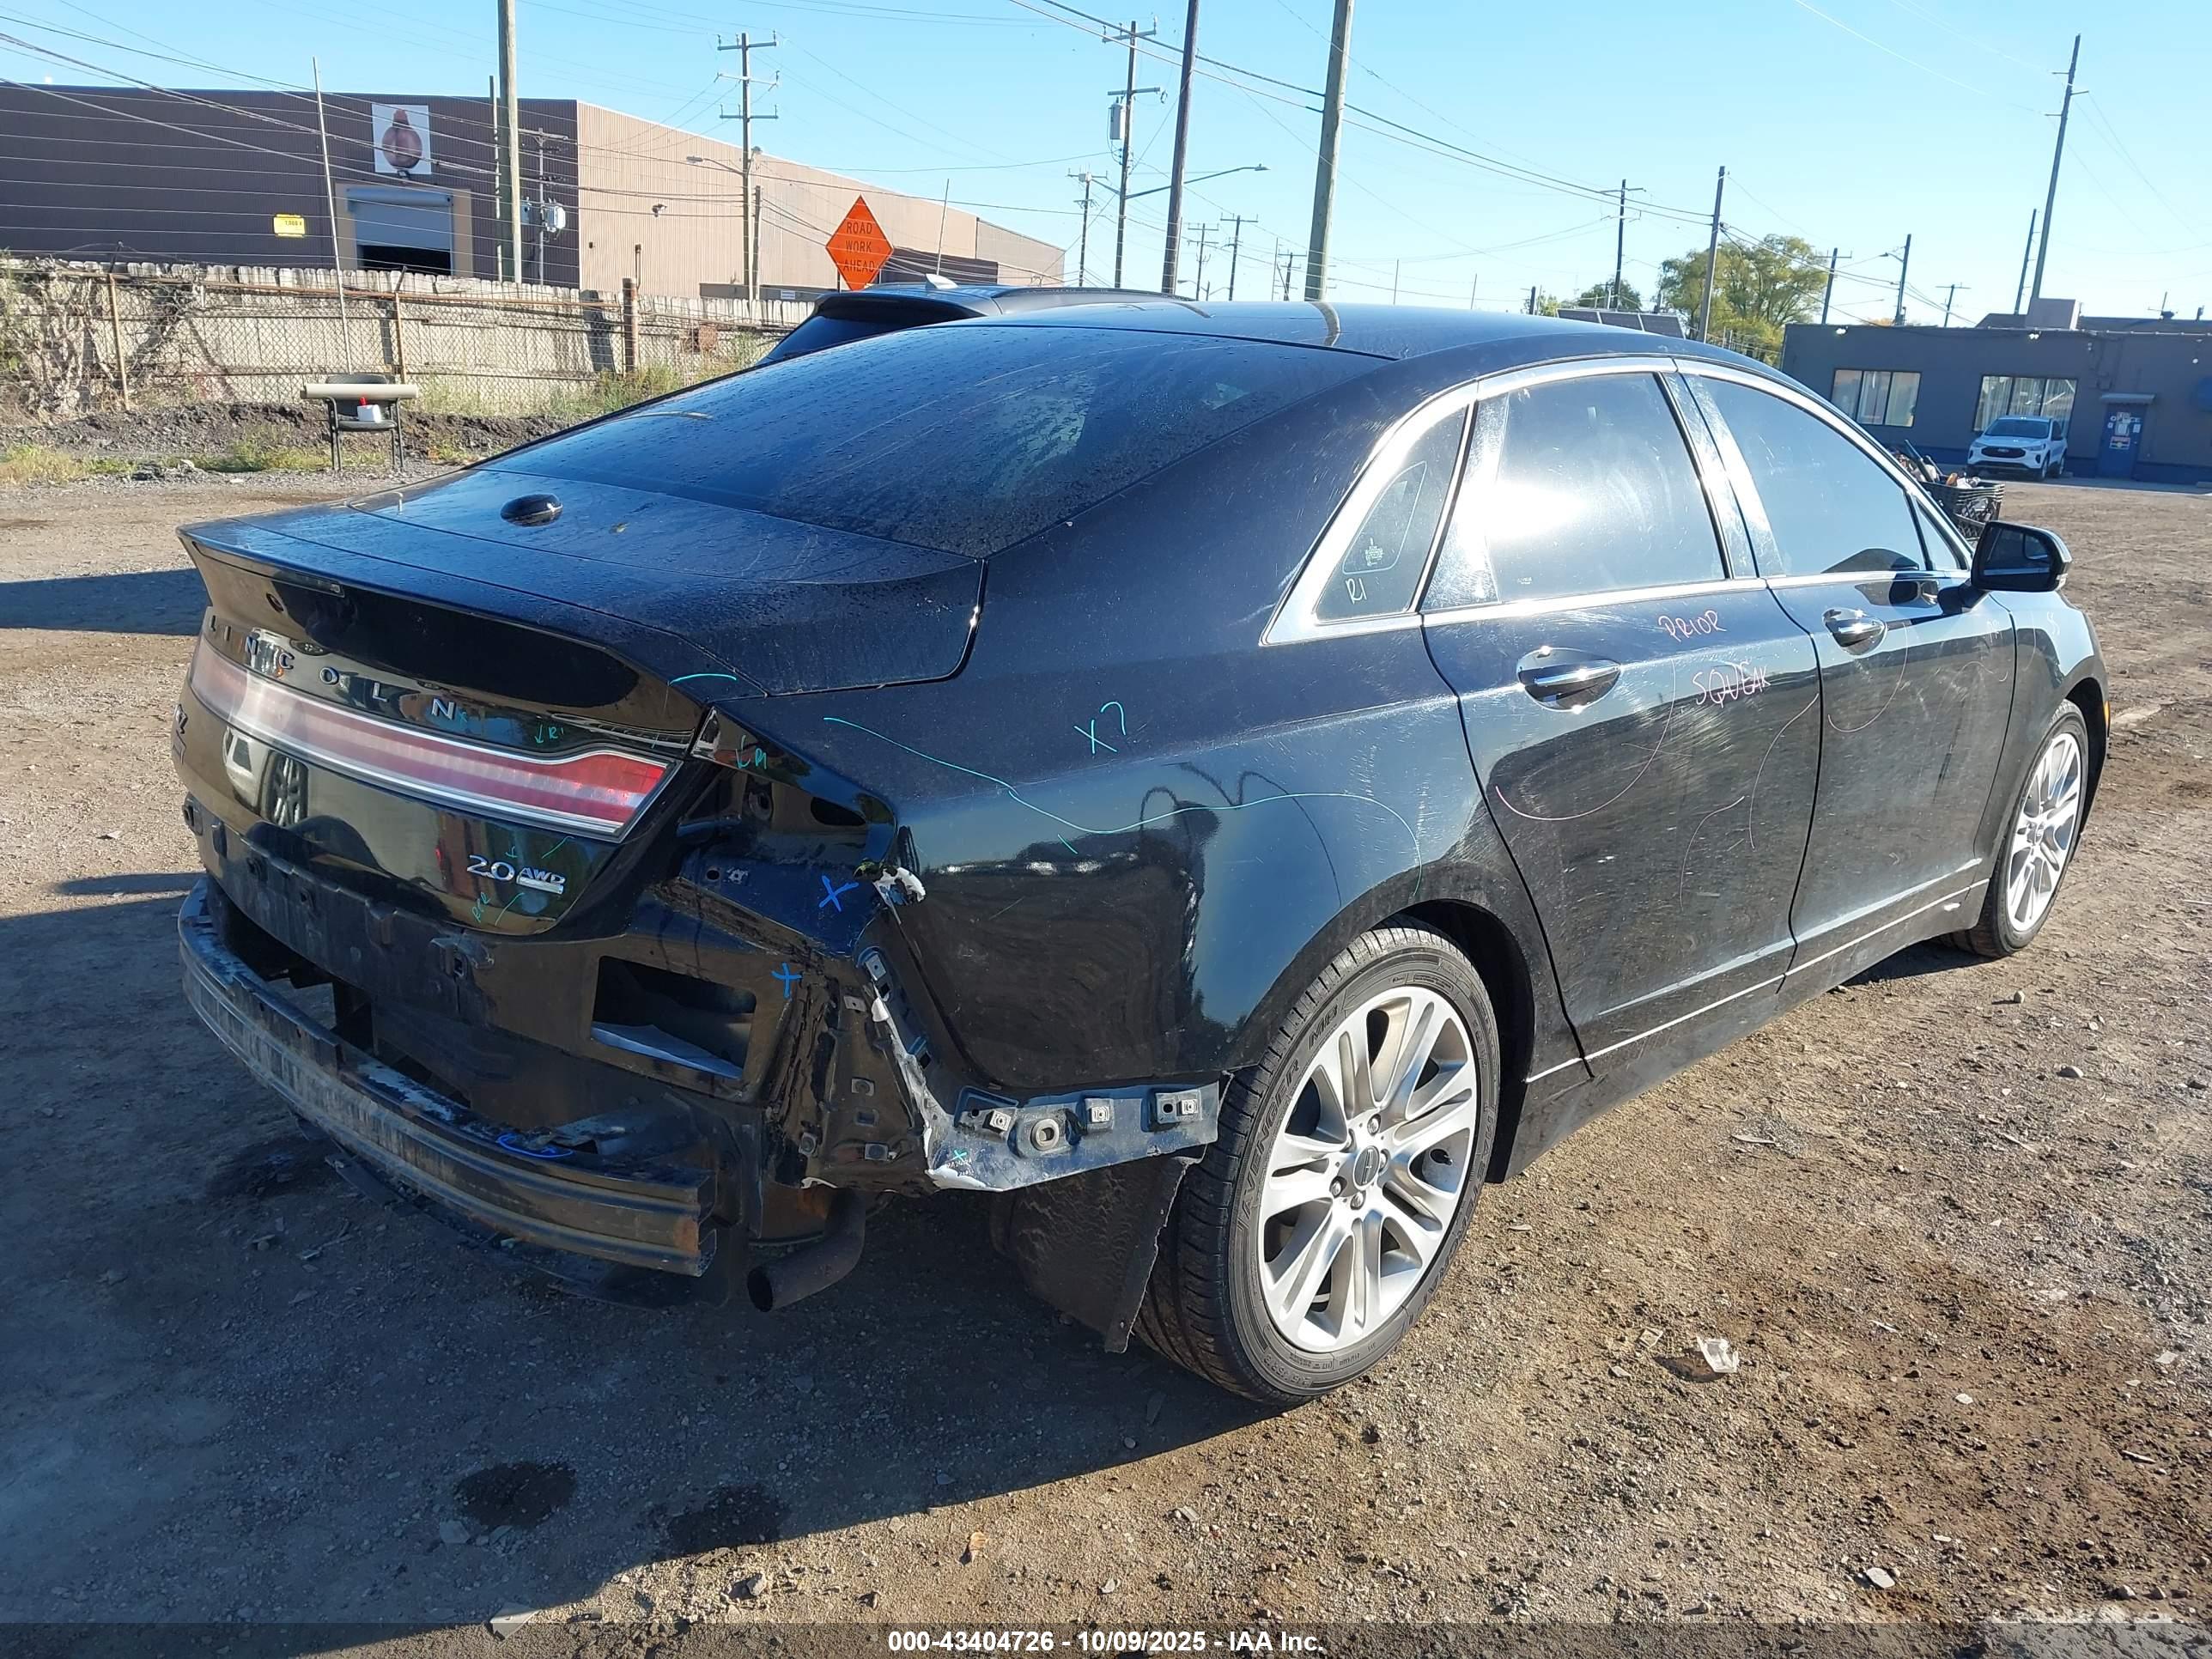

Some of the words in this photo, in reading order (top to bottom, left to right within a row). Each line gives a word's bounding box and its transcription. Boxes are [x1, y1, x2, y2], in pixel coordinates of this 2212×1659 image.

[846, 222, 872, 234] ROAD
[846, 240, 872, 252] WORK
[842, 259, 875, 273] AHEAD
[1658, 610, 1727, 642] PRIOR
[210, 615, 455, 720] LINCOLN
[518, 867, 567, 884] AWD
[1242, 1058, 1301, 1219] AVENGER
